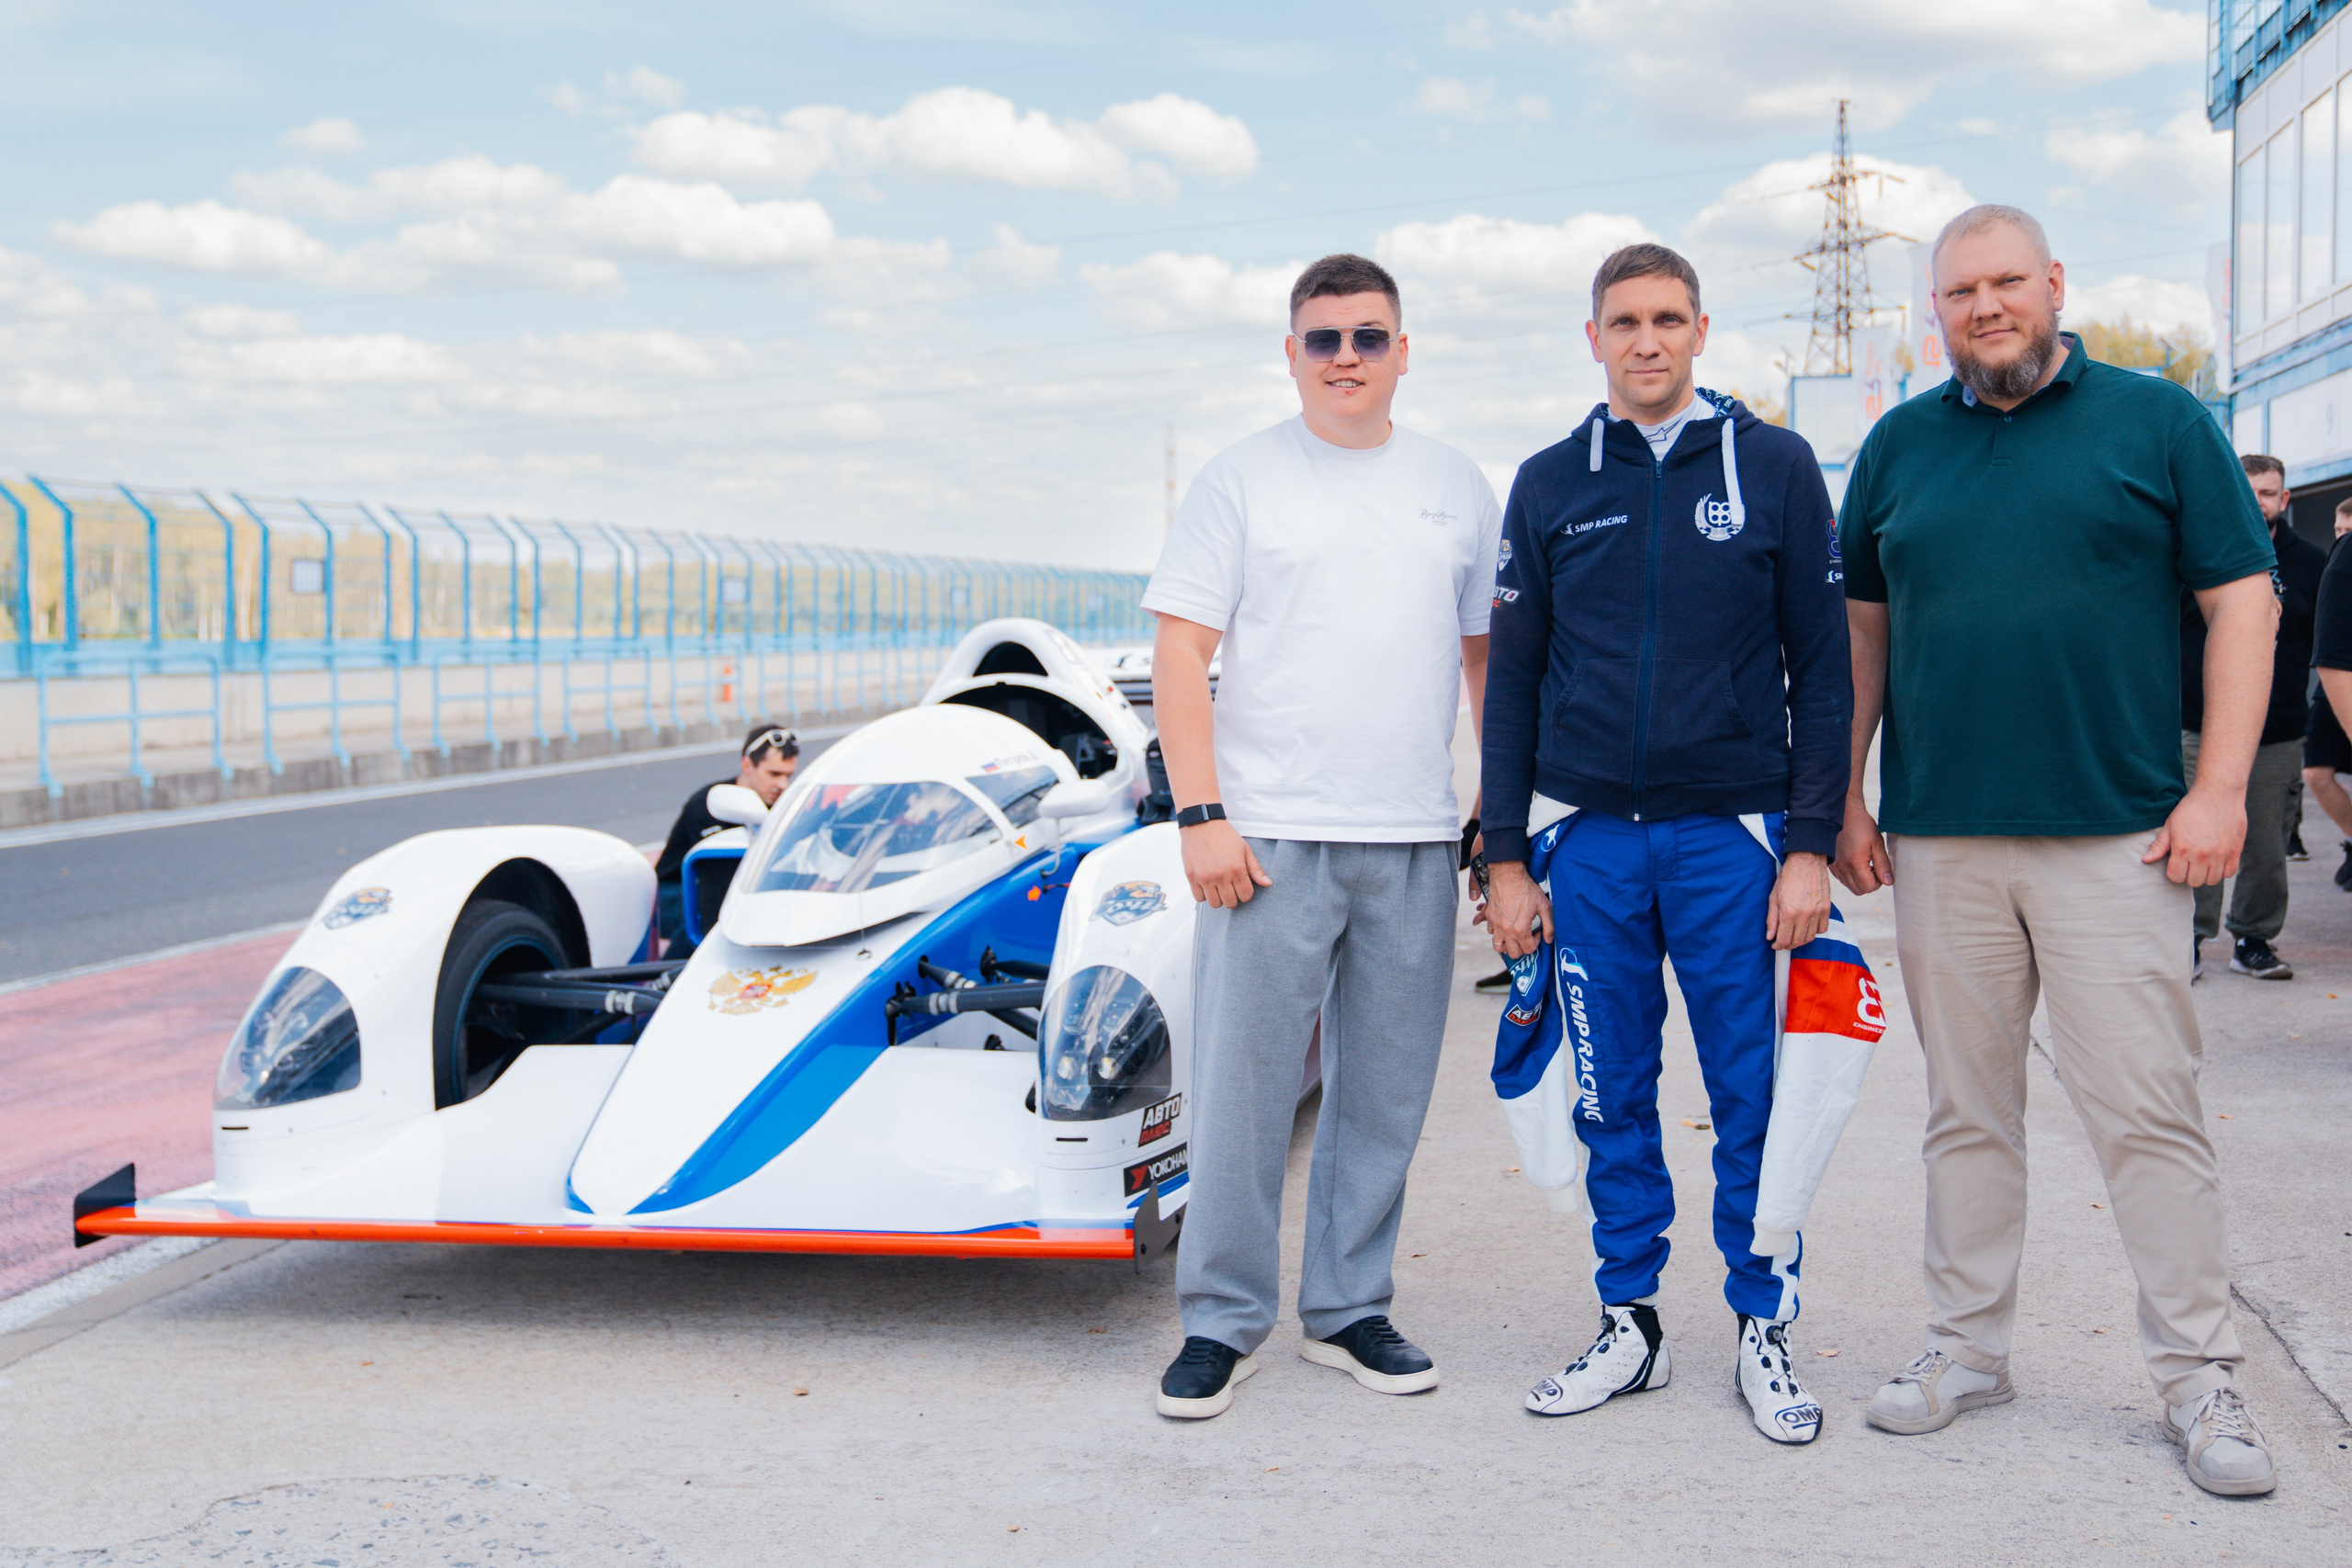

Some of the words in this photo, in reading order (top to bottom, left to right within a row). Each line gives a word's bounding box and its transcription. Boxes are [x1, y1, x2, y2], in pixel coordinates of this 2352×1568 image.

[1574, 521, 1595, 533] SMP
[1594, 514, 1628, 529] RACING
[1494, 585, 1520, 603] ВТО
[1577, 1038, 1604, 1123] RACING
[1142, 1096, 1181, 1130] АВТО
